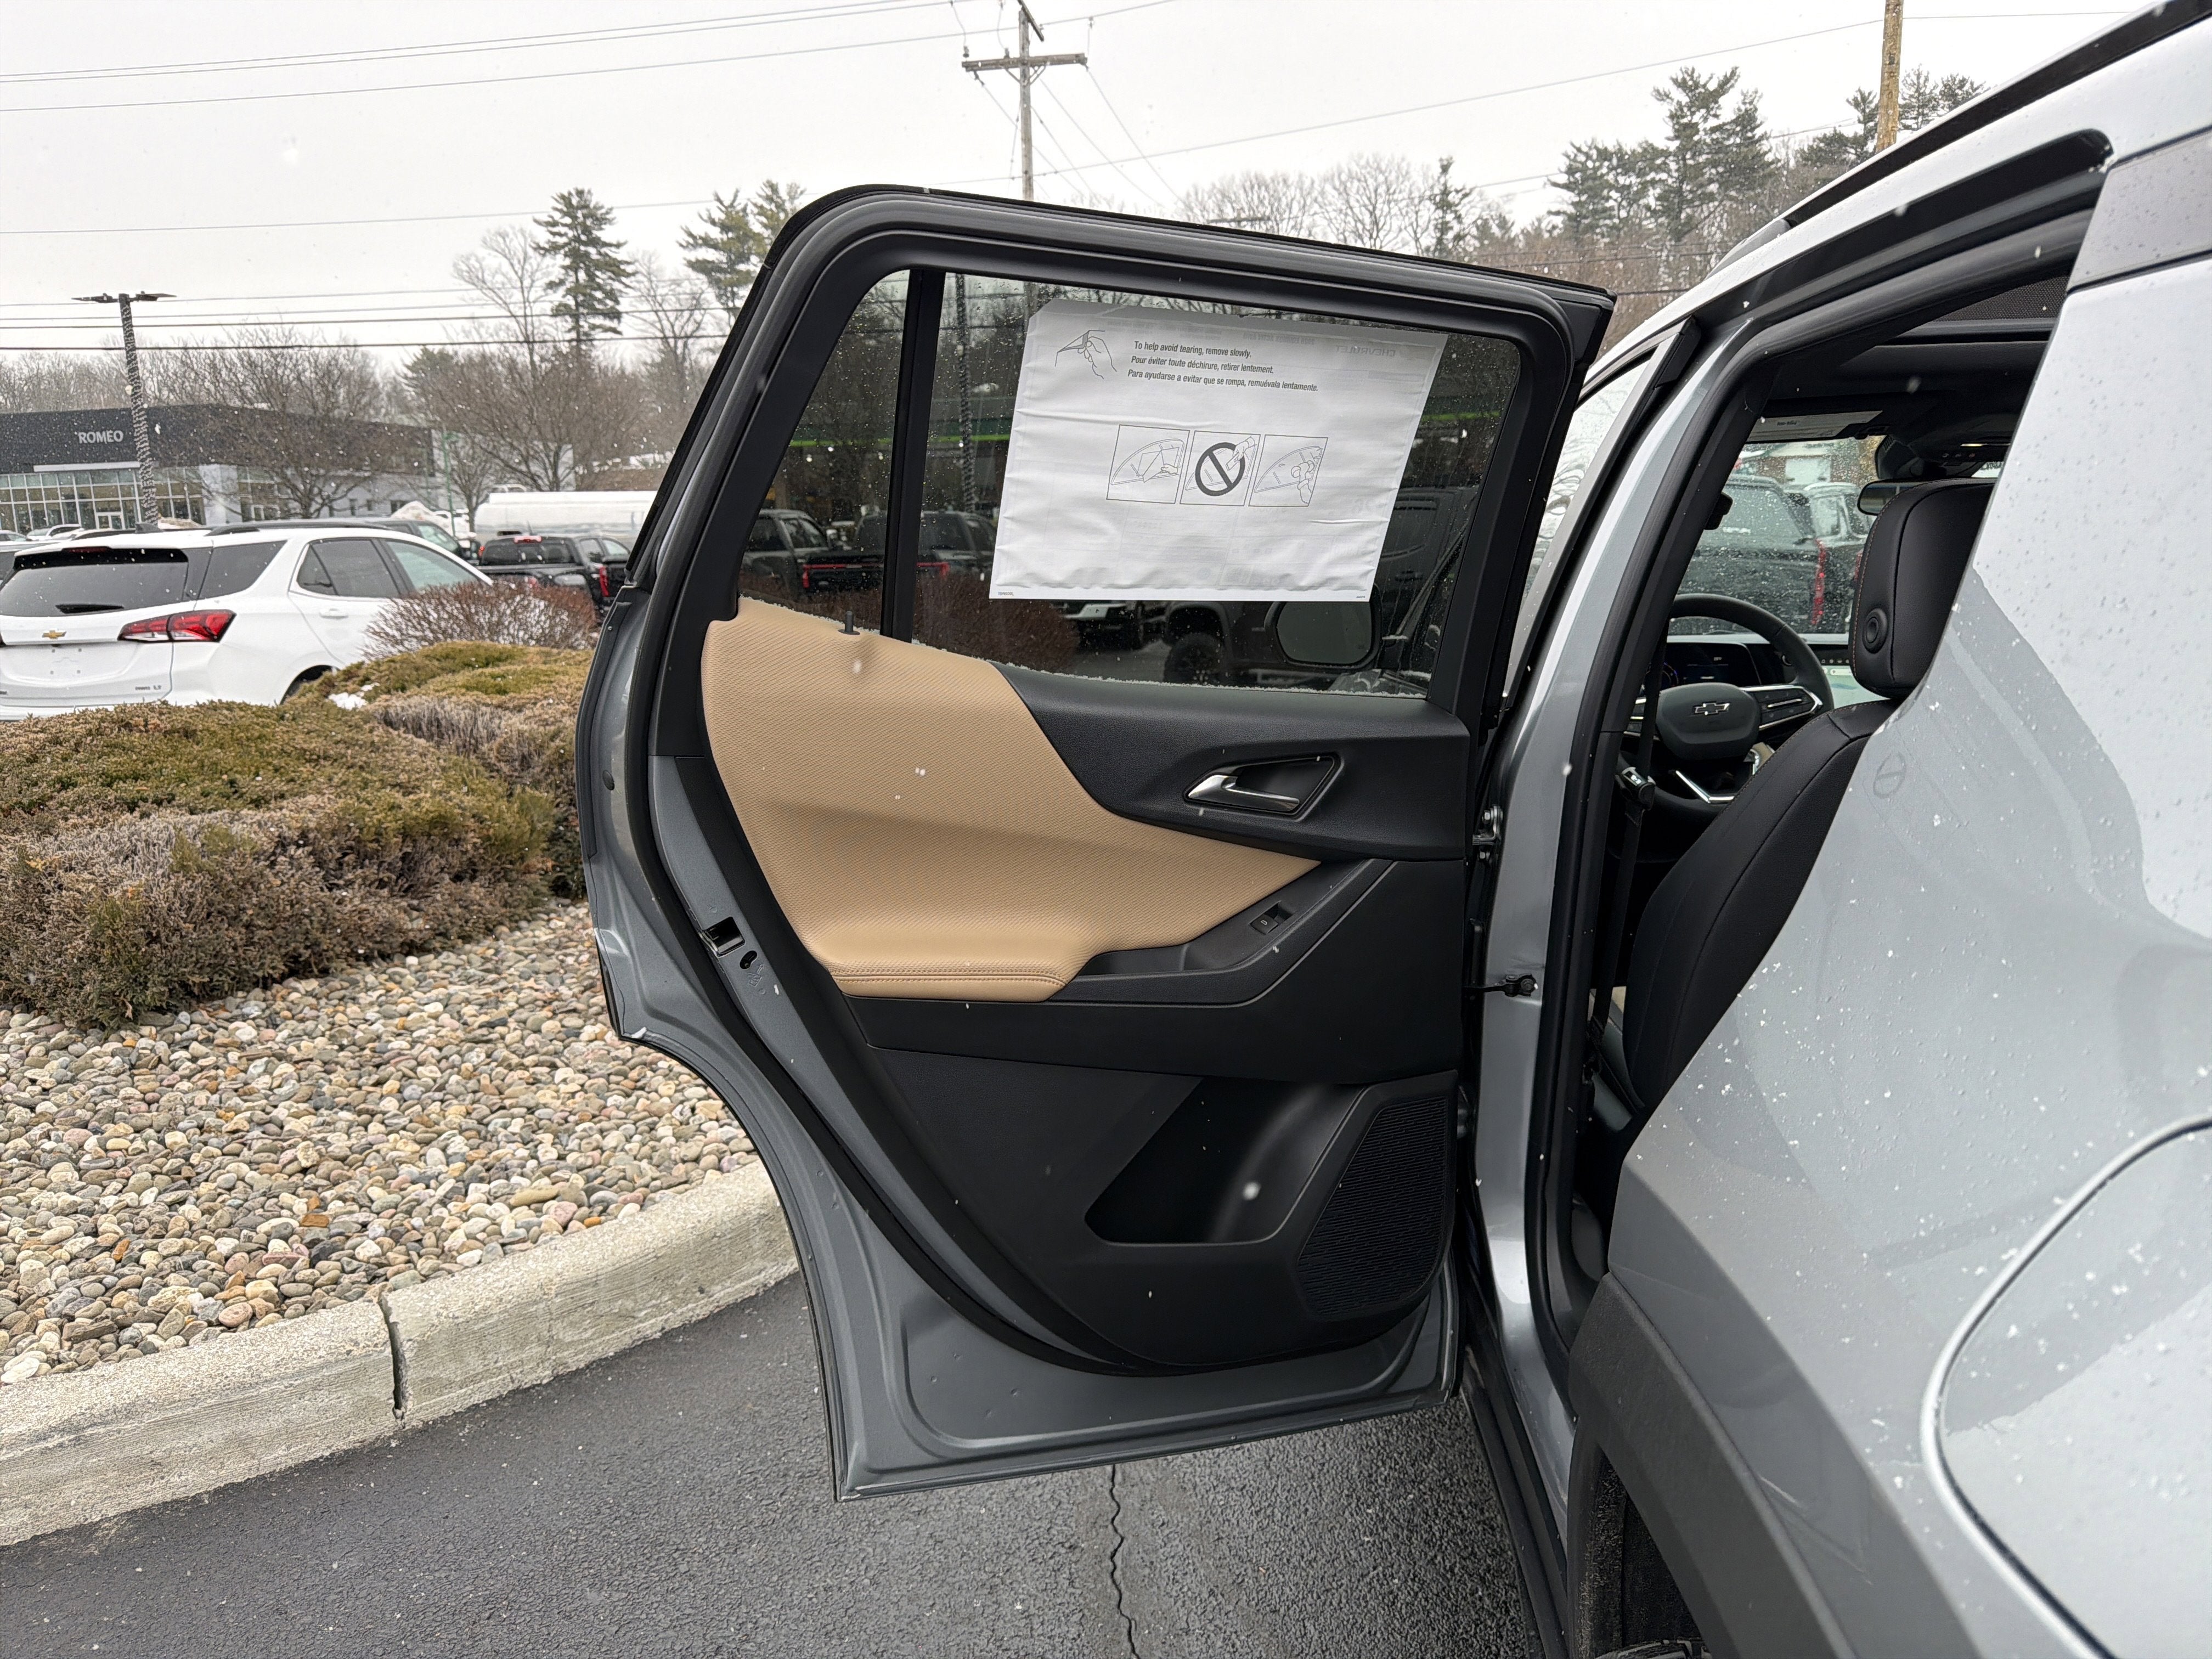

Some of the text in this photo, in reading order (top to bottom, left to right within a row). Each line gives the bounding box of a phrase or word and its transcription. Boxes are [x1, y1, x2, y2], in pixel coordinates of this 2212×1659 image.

[1135, 341, 1252, 359] To help avoid tearing, remove slowly.
[1131, 356, 1274, 374] Pour éviter toute déchirure, retirer lentement.
[1128, 369, 1143, 378] Para
[1144, 371, 1176, 381] ayudarse
[1183, 375, 1203, 383] evitar
[1203, 377, 1215, 386] que
[1226, 379, 1246, 387] rompa,
[1248, 379, 1280, 388] remuévala
[1282, 381, 1318, 392] lentamente.
[78, 430, 124, 444] ROMEO
